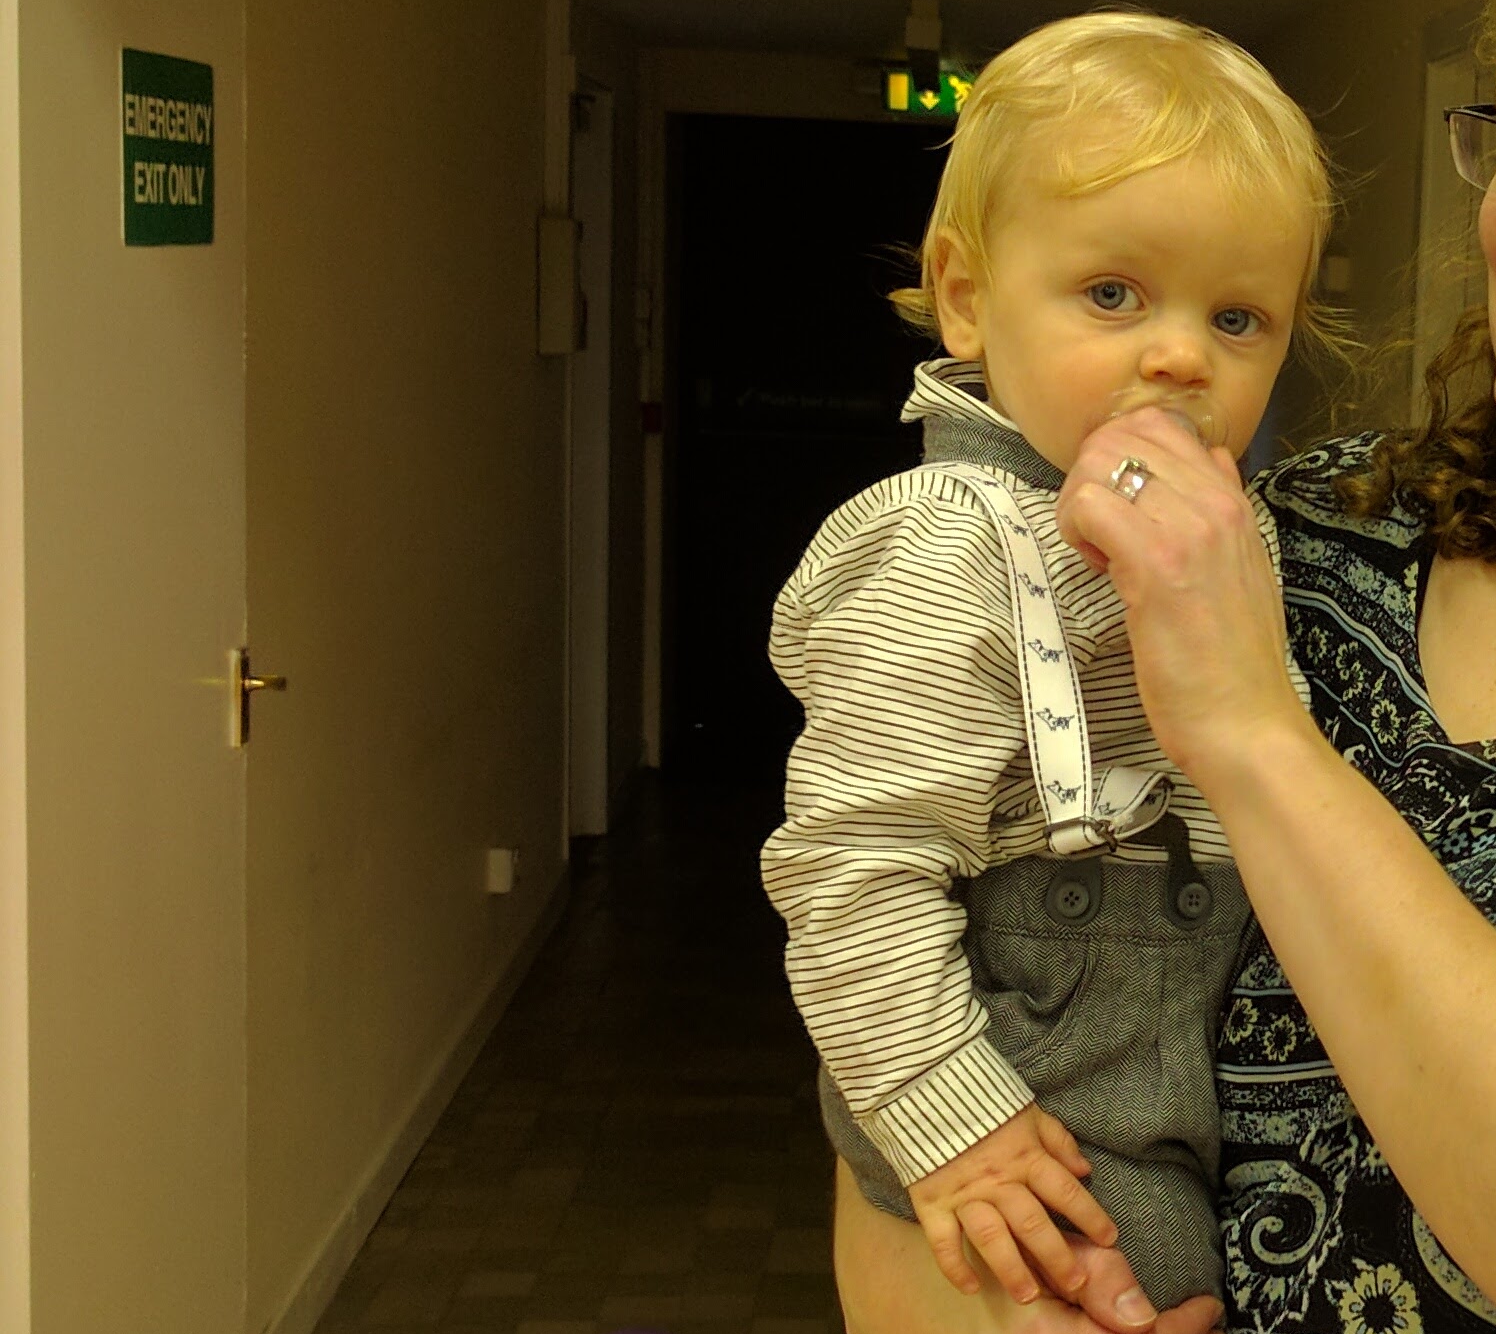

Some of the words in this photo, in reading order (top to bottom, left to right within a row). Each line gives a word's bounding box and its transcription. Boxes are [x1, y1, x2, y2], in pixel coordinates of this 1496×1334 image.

[124, 93, 212, 146] EMERGENCY
[133, 160, 166, 205] EXIT
[168, 161, 206, 206] ONLY
